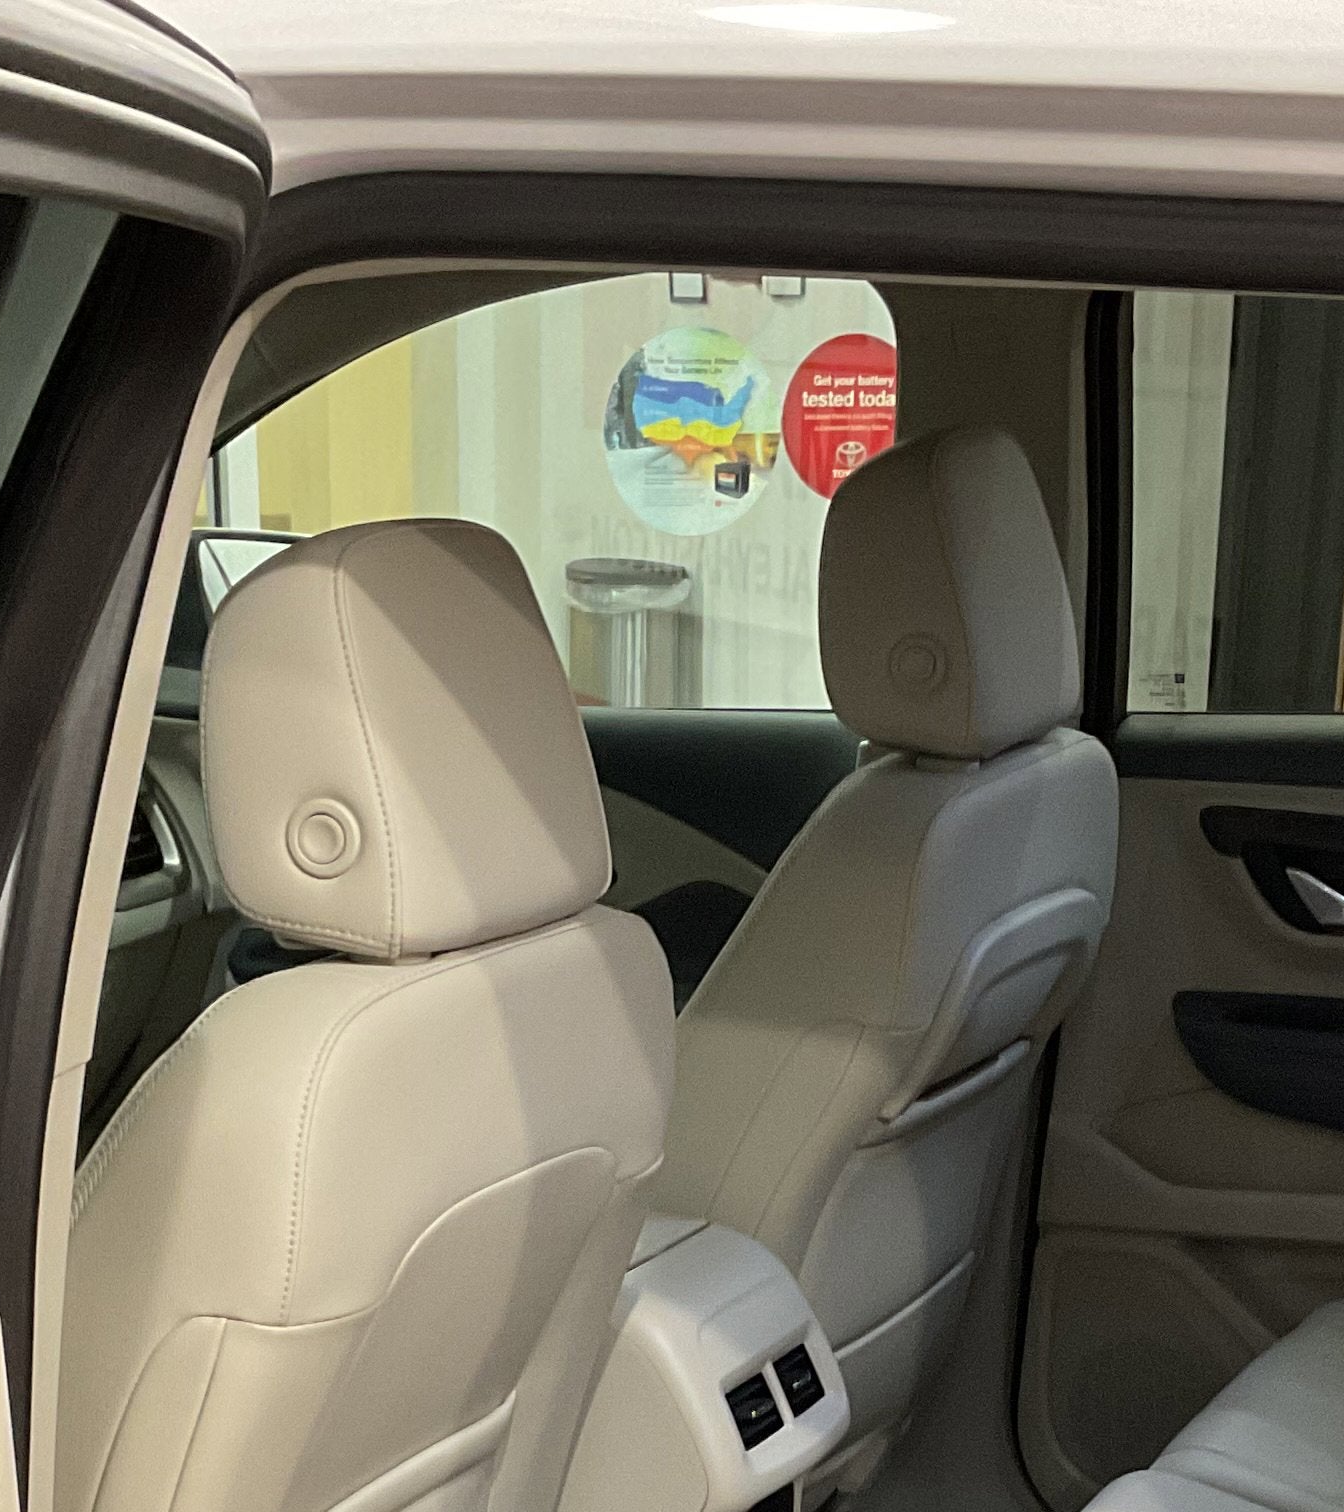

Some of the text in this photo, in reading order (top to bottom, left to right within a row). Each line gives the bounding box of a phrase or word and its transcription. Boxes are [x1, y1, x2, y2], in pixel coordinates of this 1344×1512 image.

[813, 374, 895, 389] Get your battery
[802, 389, 897, 408] tested toda
